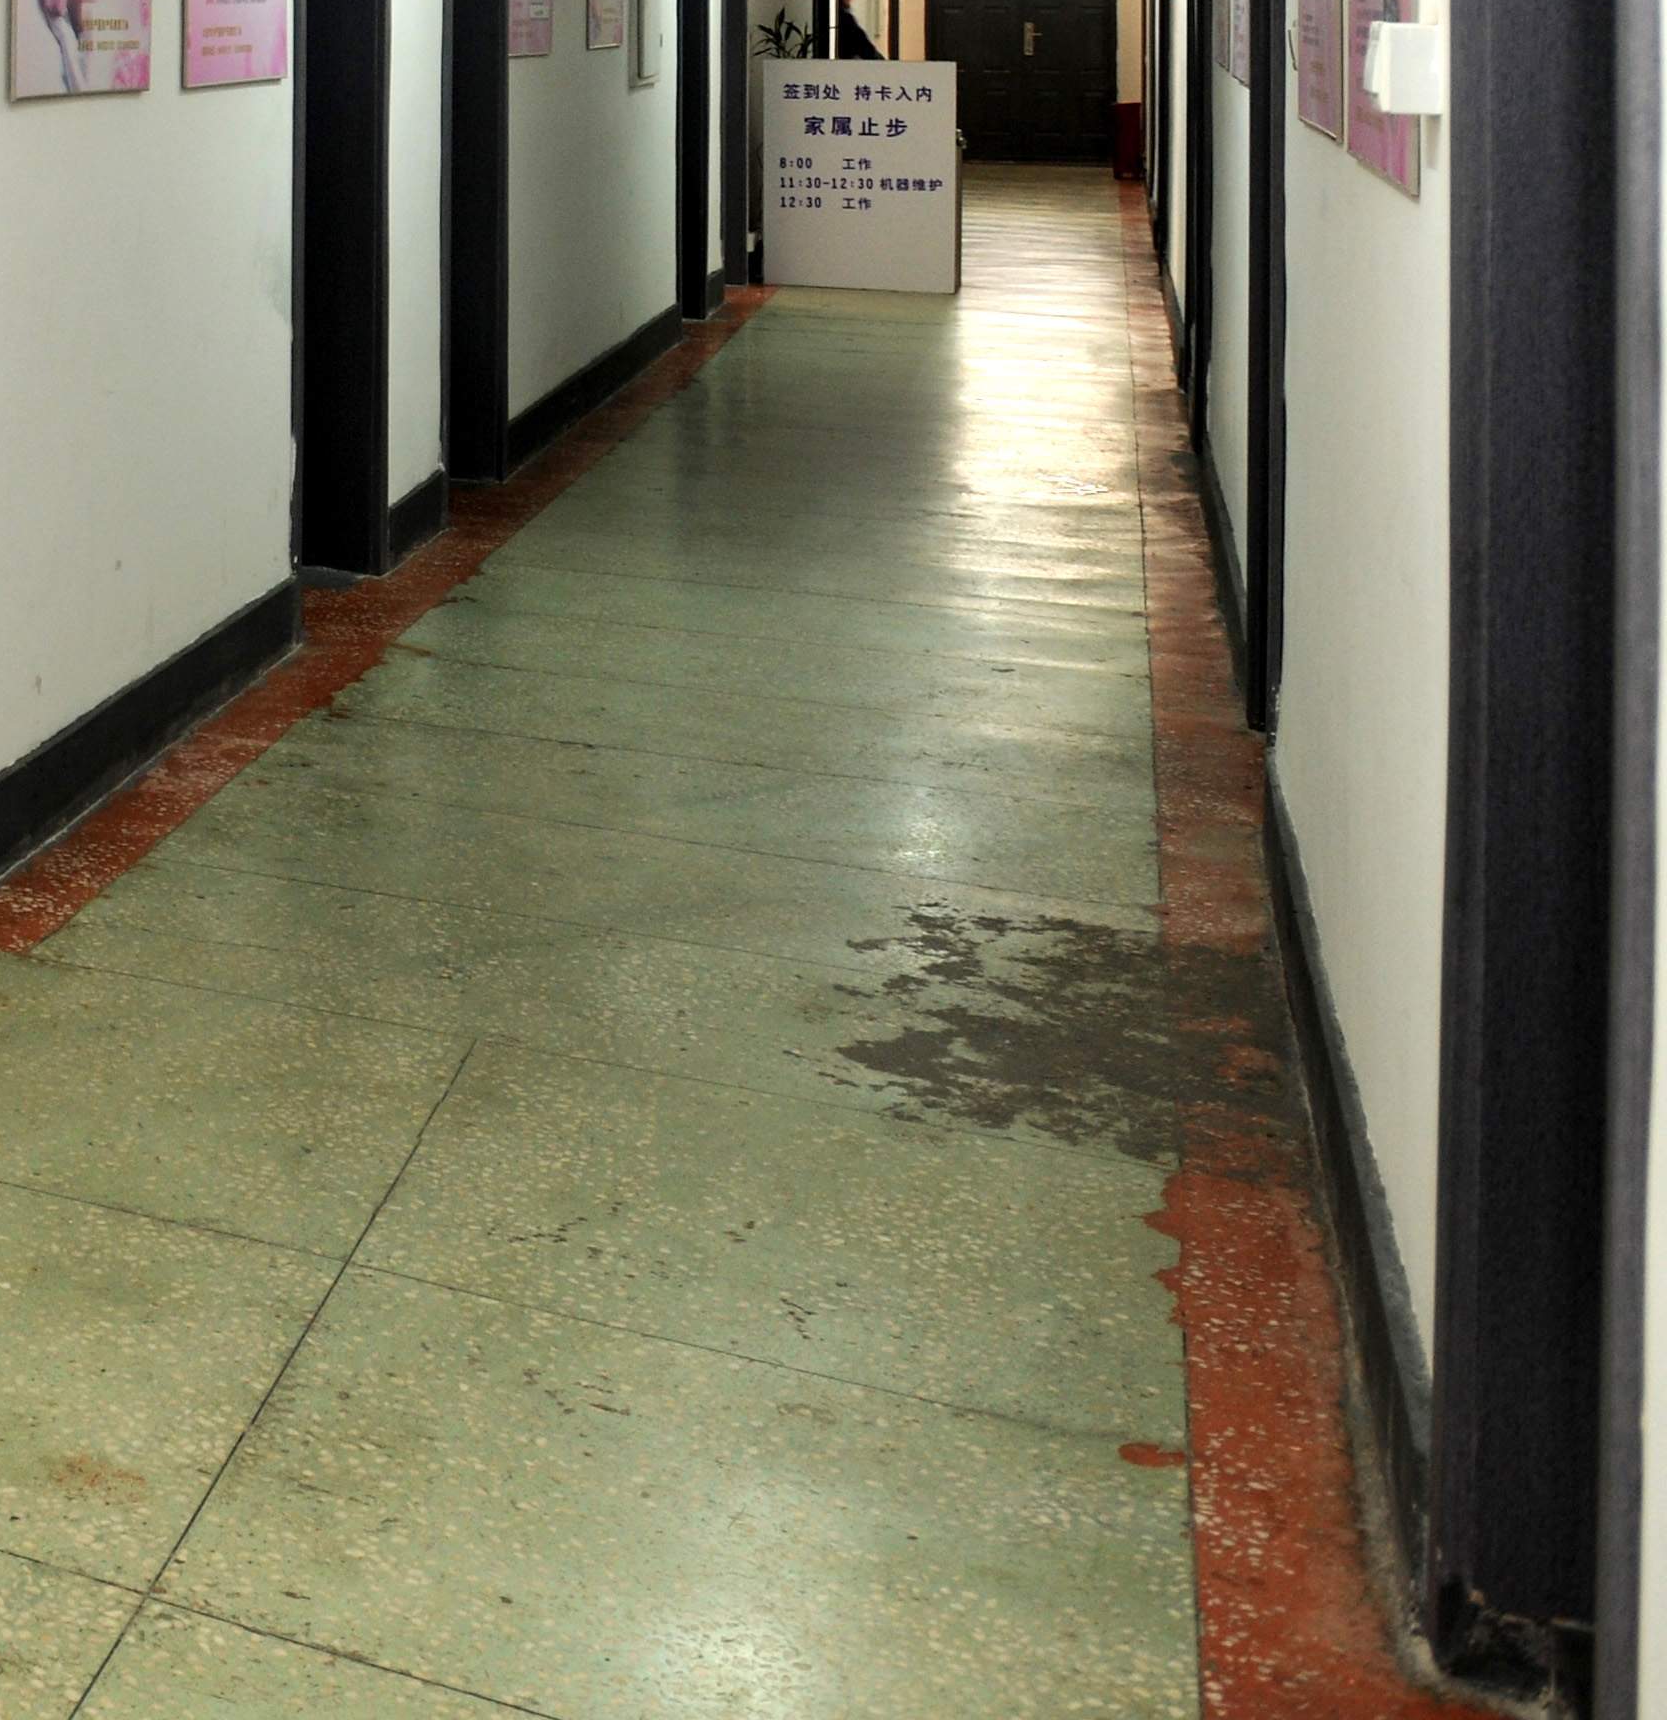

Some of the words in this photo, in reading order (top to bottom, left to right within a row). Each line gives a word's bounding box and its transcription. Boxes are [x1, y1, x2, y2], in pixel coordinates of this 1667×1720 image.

[783, 83, 840, 101] 签到处
[854, 85, 933, 102] 持卡入内
[803, 116, 908, 138] 家属止步
[779, 157, 813, 169] 8:00
[842, 158, 872, 170] 工作
[779, 177, 874, 190] 11:30-12:30
[880, 178, 944, 192] 机器维护
[779, 197, 822, 209] 12:30
[842, 197, 872, 210] 工作
